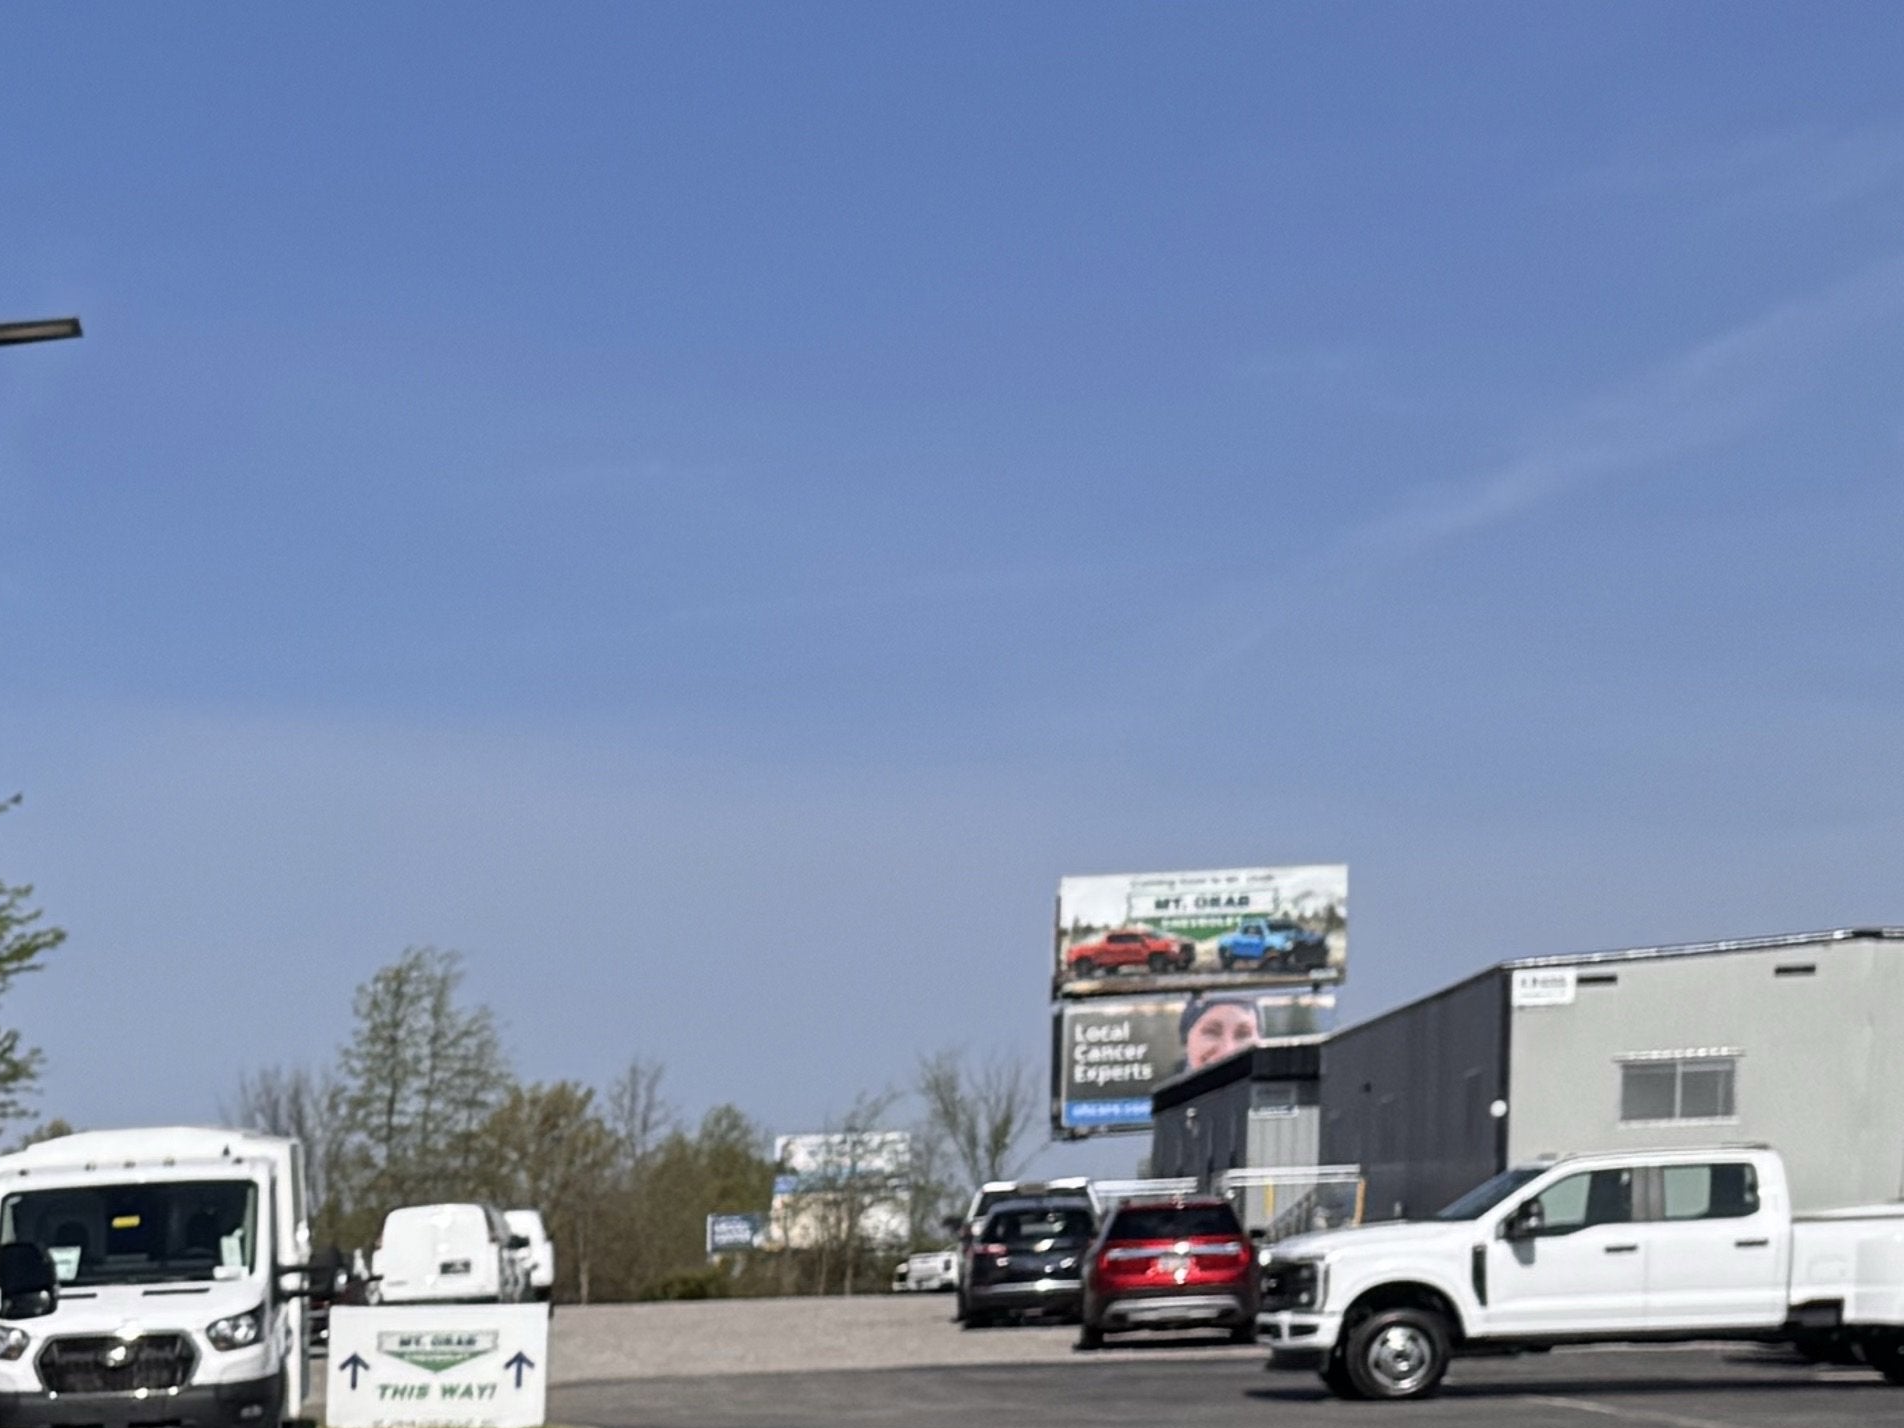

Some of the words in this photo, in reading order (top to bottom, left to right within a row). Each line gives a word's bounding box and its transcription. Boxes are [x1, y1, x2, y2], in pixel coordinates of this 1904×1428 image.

[1074, 1021, 1130, 1042] Local
[1074, 1043, 1148, 1062] Cancer
[1074, 1063, 1153, 1087] Experts
[378, 1383, 431, 1401] THIS
[440, 1382, 498, 1400] WAY!
